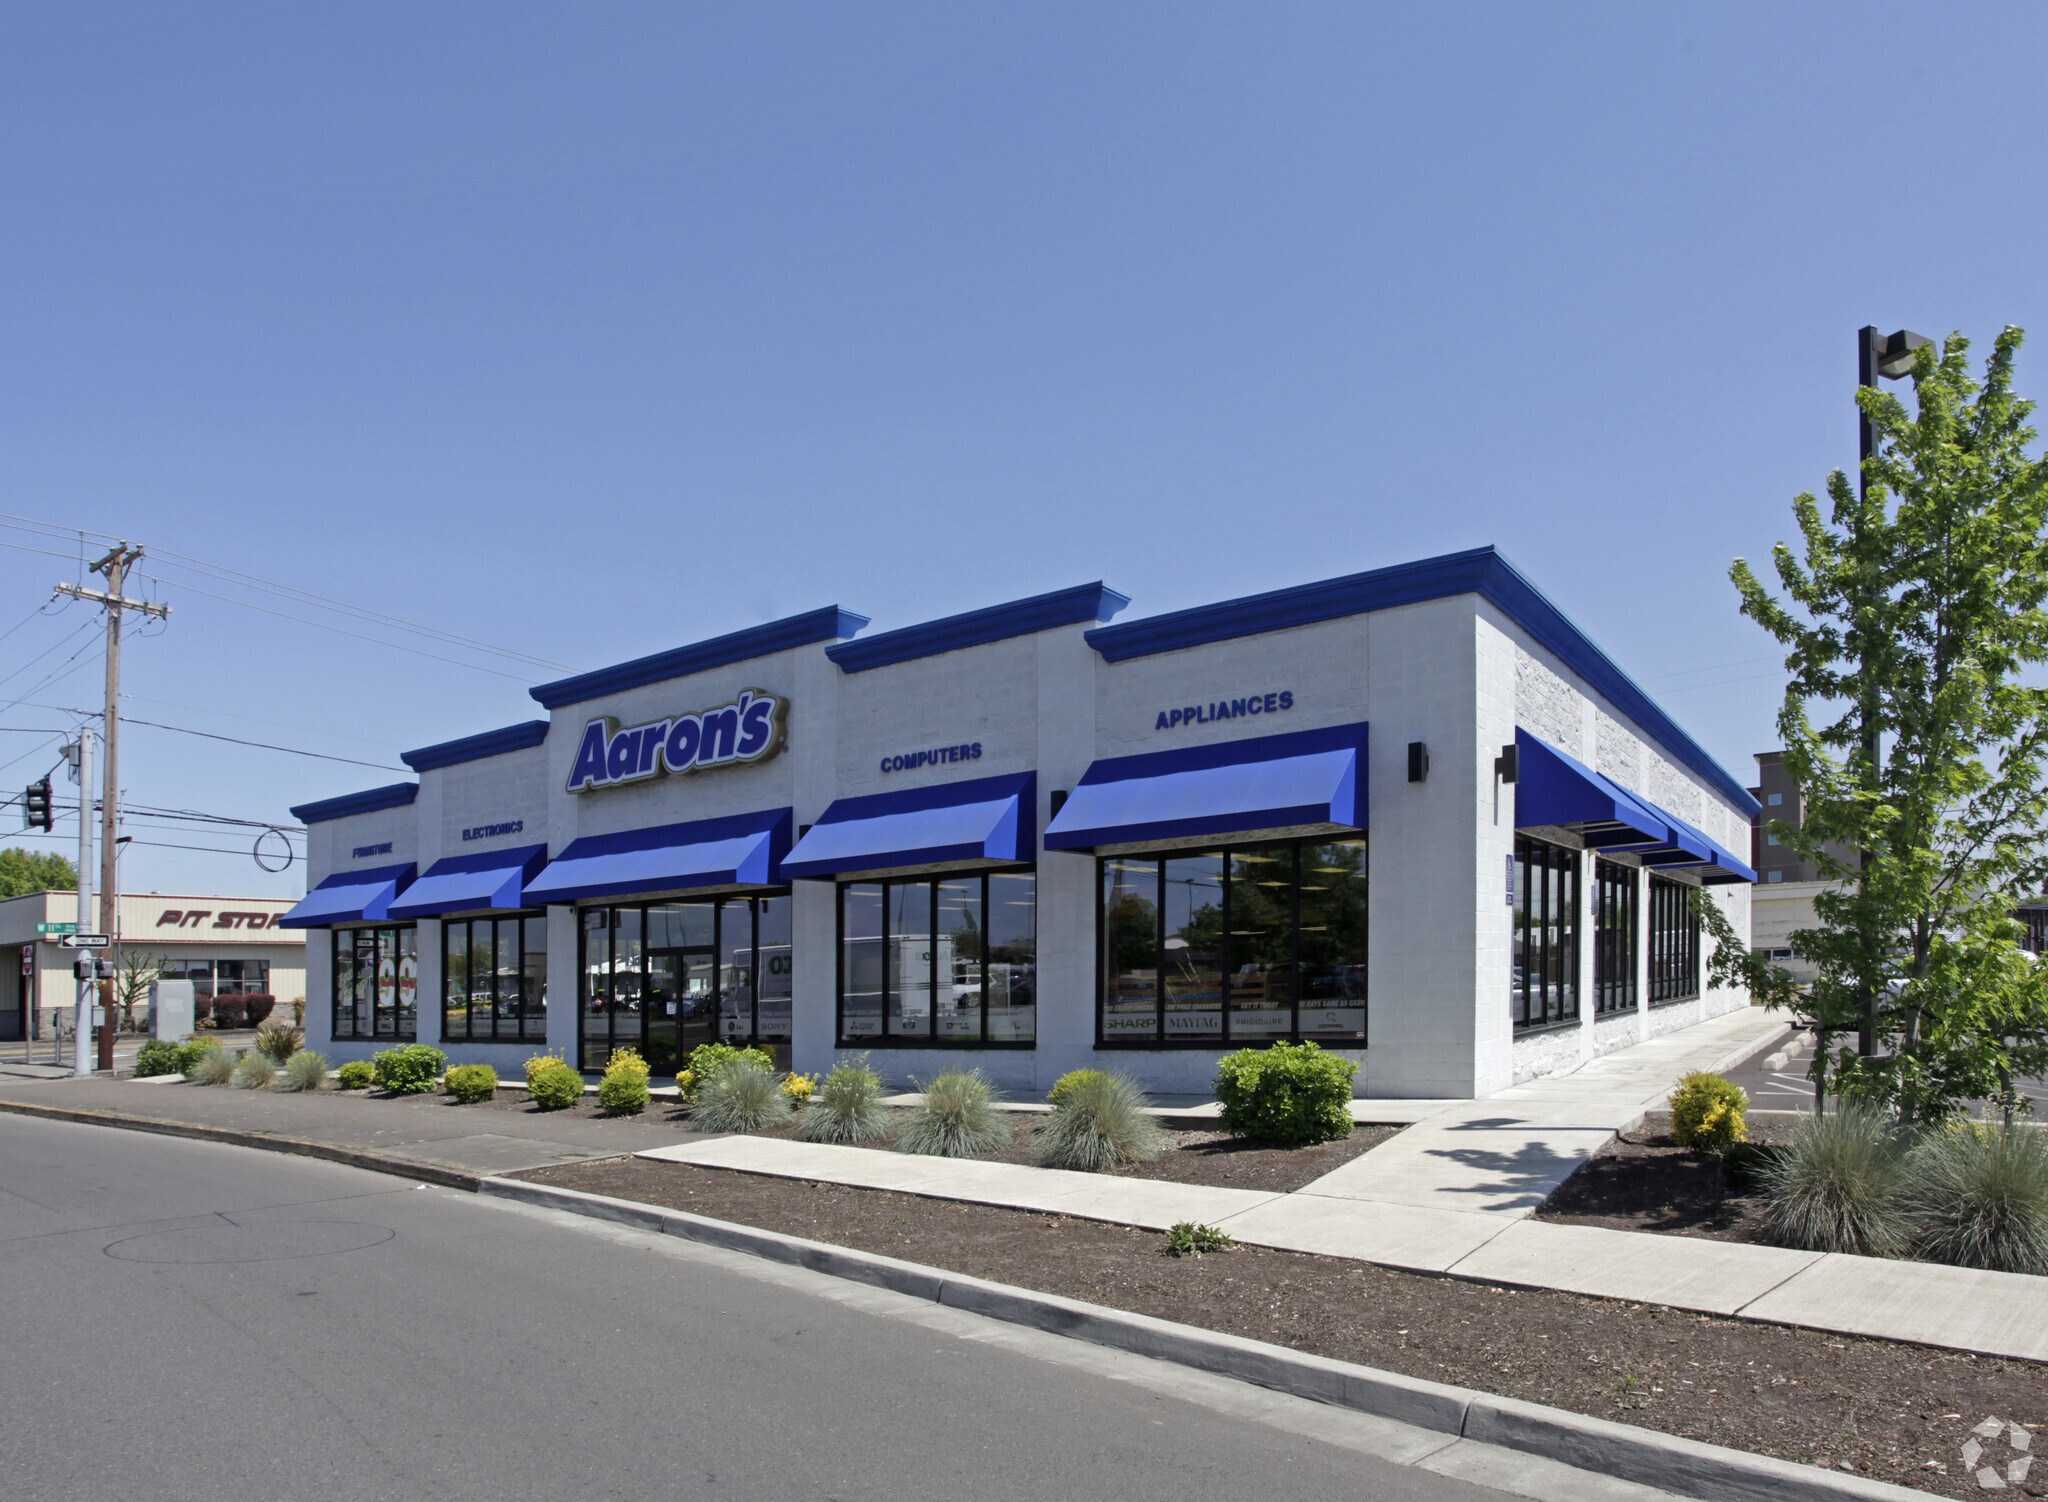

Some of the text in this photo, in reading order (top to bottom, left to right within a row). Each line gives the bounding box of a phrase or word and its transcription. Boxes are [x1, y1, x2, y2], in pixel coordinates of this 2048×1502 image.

[1155, 690, 1294, 731] APPLIANCES
[568, 691, 776, 790] Aaron's
[880, 742, 983, 774] COMPUTERS
[462, 820, 524, 841] ELECTRONICS
[352, 842, 393, 859] FURNITURE
[155, 910, 212, 928] PIT
[37, 923, 46, 933] W
[1306, 1000, 1321, 1008] DAYS
[1322, 999, 1339, 1007] SAME
[1339, 999, 1348, 1007] AS
[761, 1022, 788, 1031] SONY
[1104, 1018, 1157, 1029] SHARP
[1168, 1017, 1218, 1029] MAYTAG
[1236, 1017, 1283, 1026] FRIGIDAIRE
